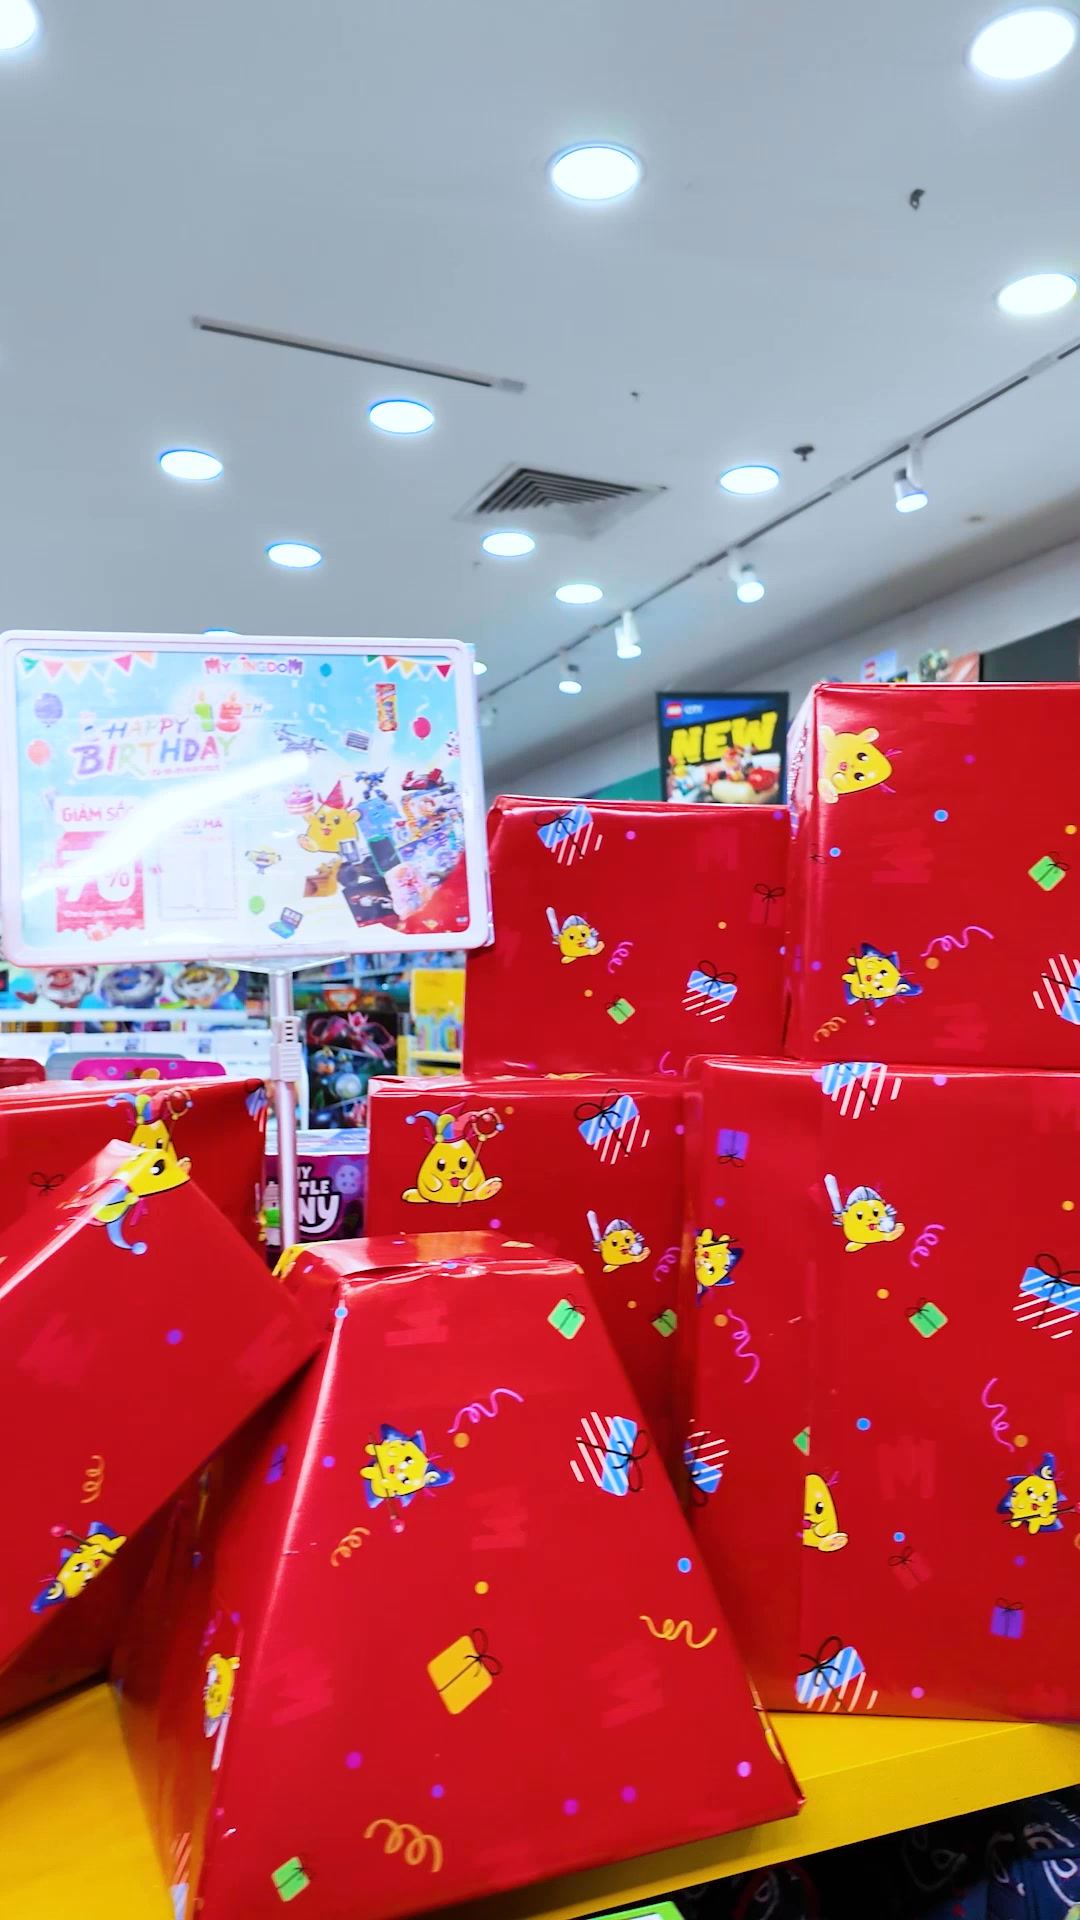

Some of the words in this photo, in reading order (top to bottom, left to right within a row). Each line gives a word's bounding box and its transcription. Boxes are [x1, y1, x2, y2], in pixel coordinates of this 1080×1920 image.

[102, 718, 189, 739] HAPPY
[670, 711, 778, 764] NEW
[72, 736, 237, 775] BIRTHDAY
[298, 1179, 330, 1196] TLE
[298, 1194, 340, 1234] NY
